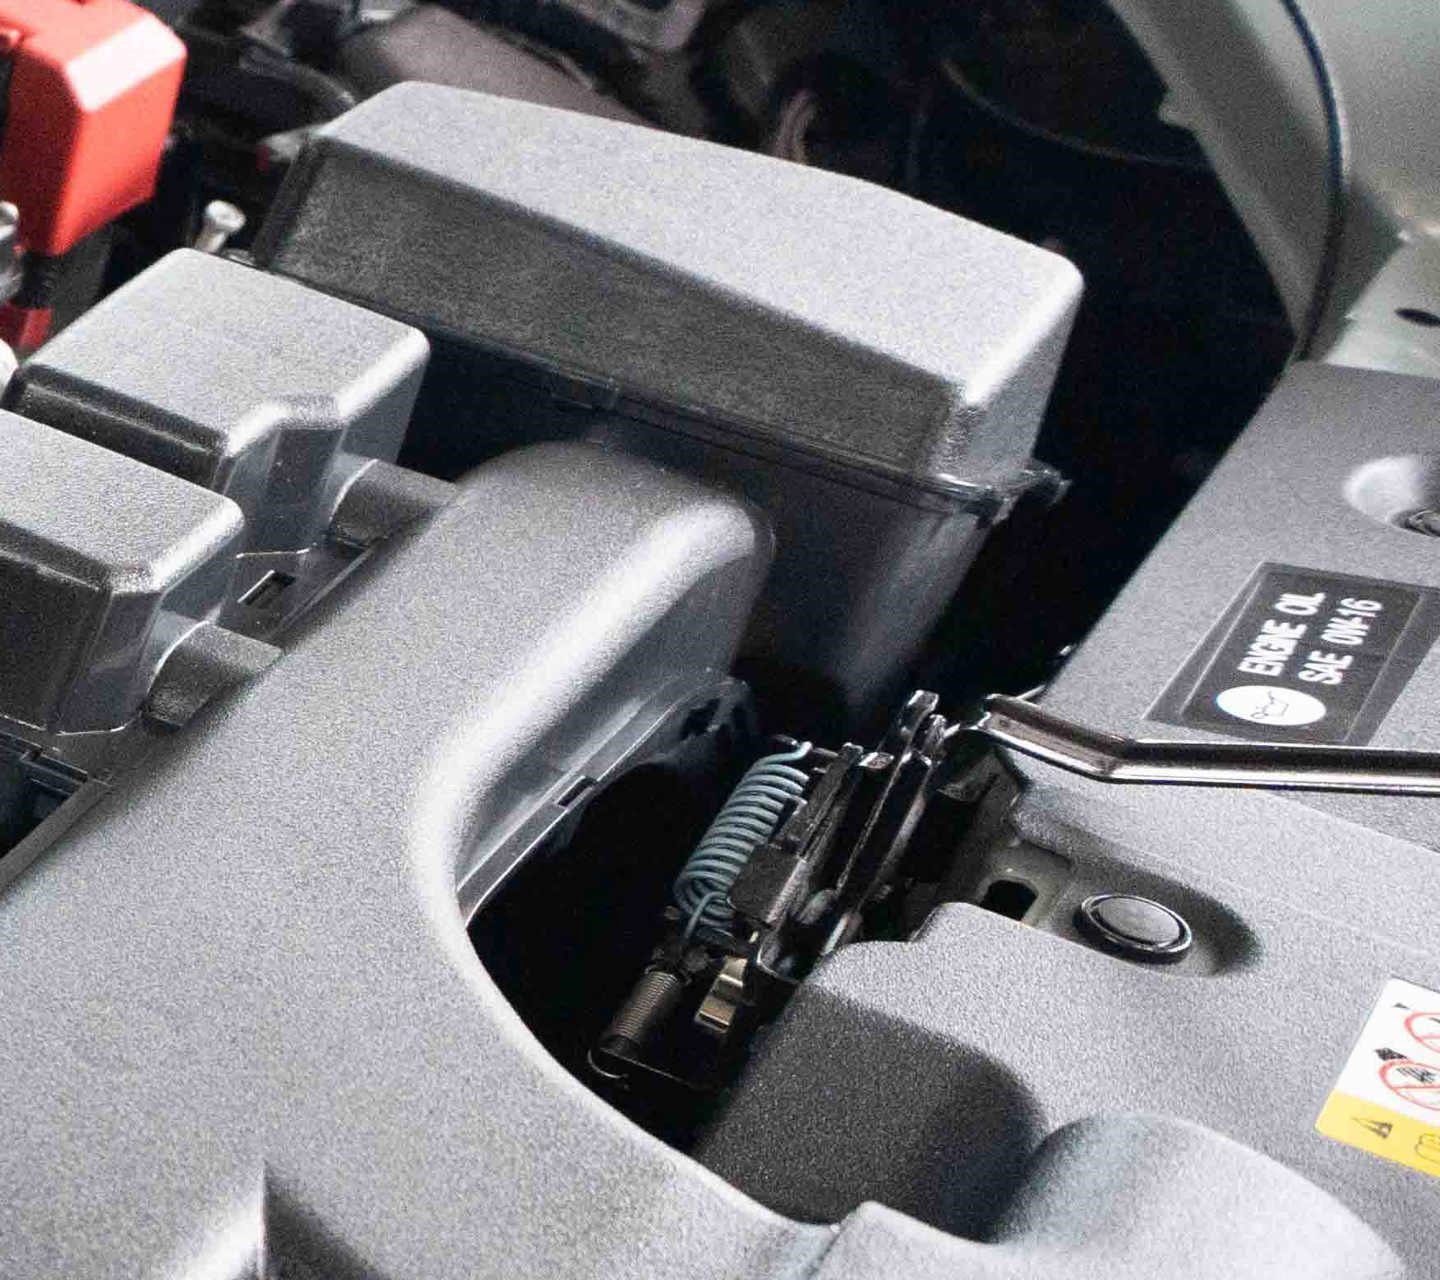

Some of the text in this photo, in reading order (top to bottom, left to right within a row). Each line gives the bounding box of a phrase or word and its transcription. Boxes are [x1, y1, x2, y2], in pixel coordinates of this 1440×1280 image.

[1237, 592, 1326, 676] ENGINE OIL
[1298, 651, 1353, 685] SAE
